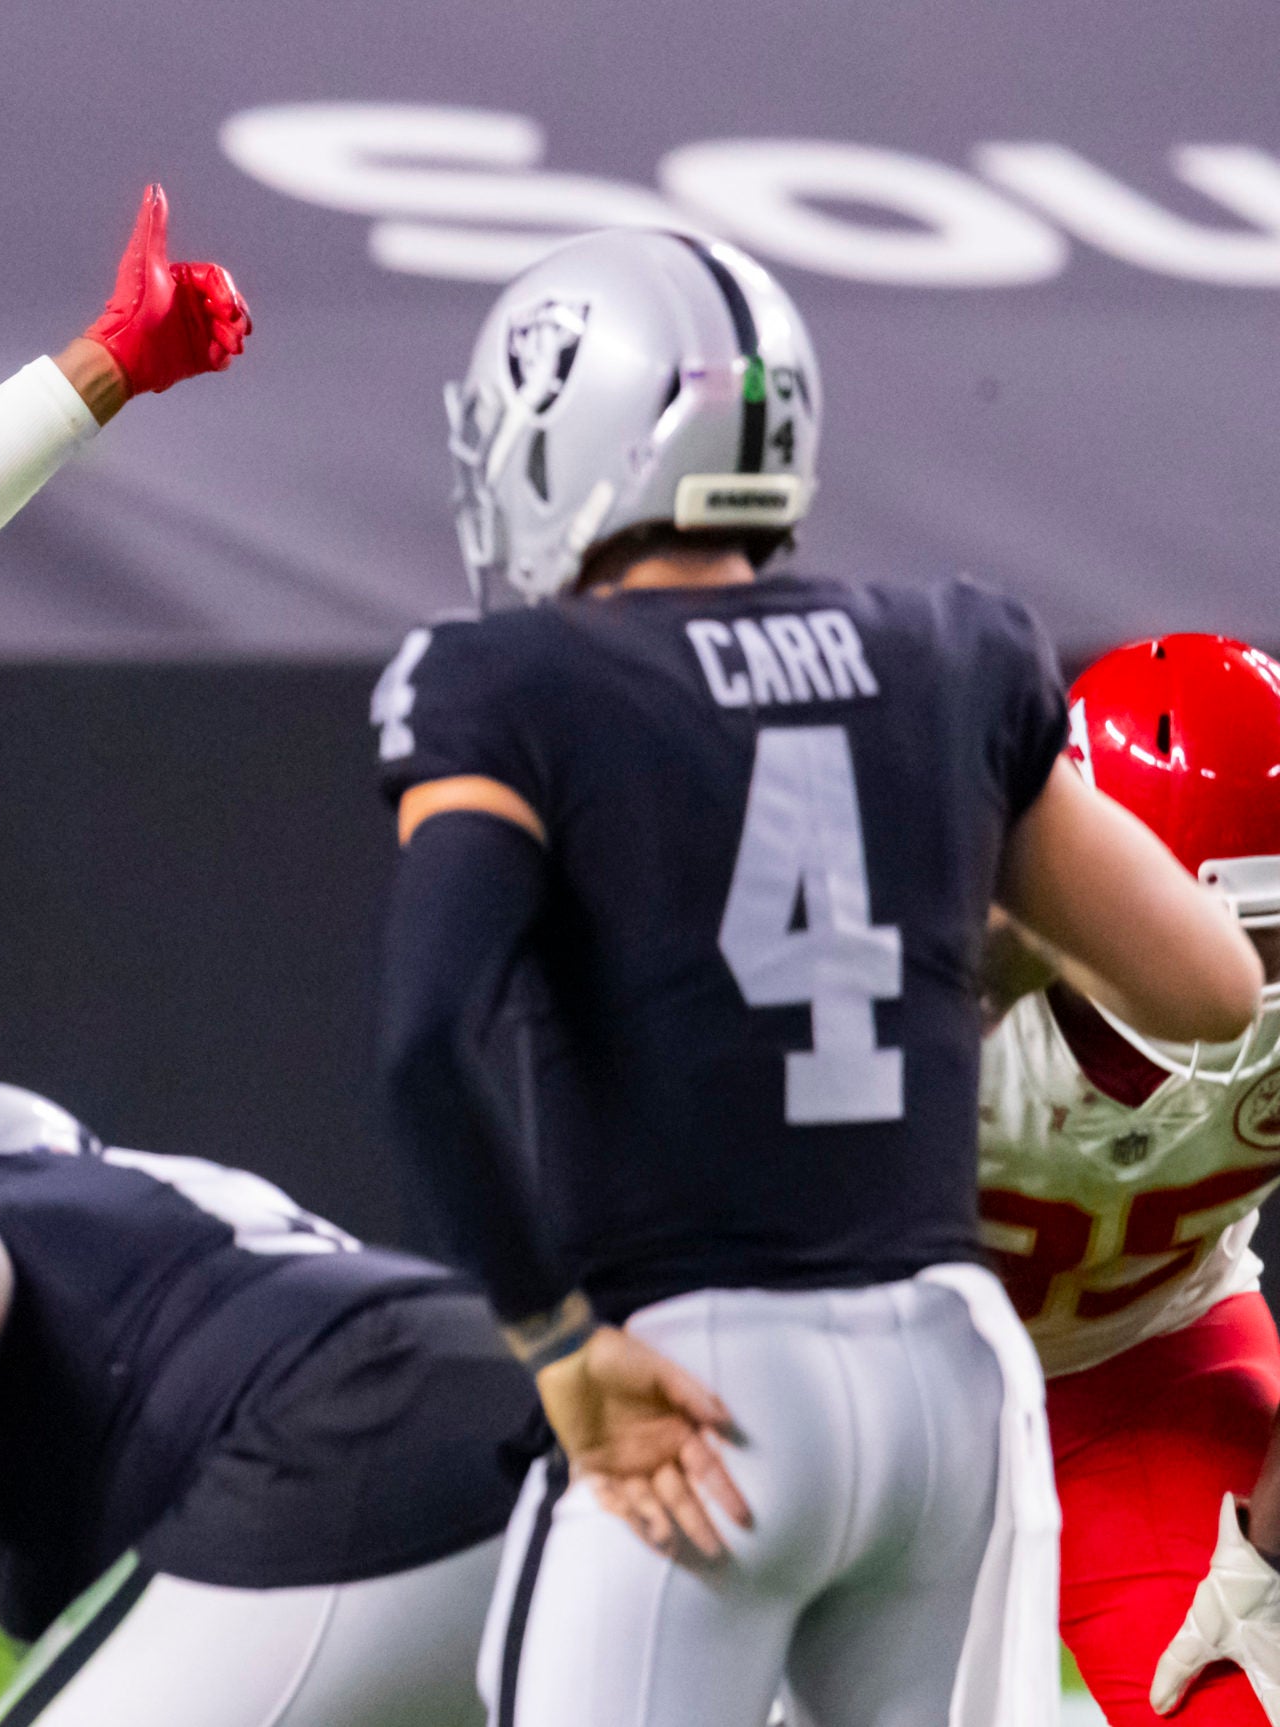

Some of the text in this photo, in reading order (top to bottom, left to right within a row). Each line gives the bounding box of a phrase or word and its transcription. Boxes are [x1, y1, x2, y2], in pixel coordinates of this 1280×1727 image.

[772, 418, 795, 466] 4
[685, 609, 878, 709] CARR
[718, 724, 906, 1126] 4
